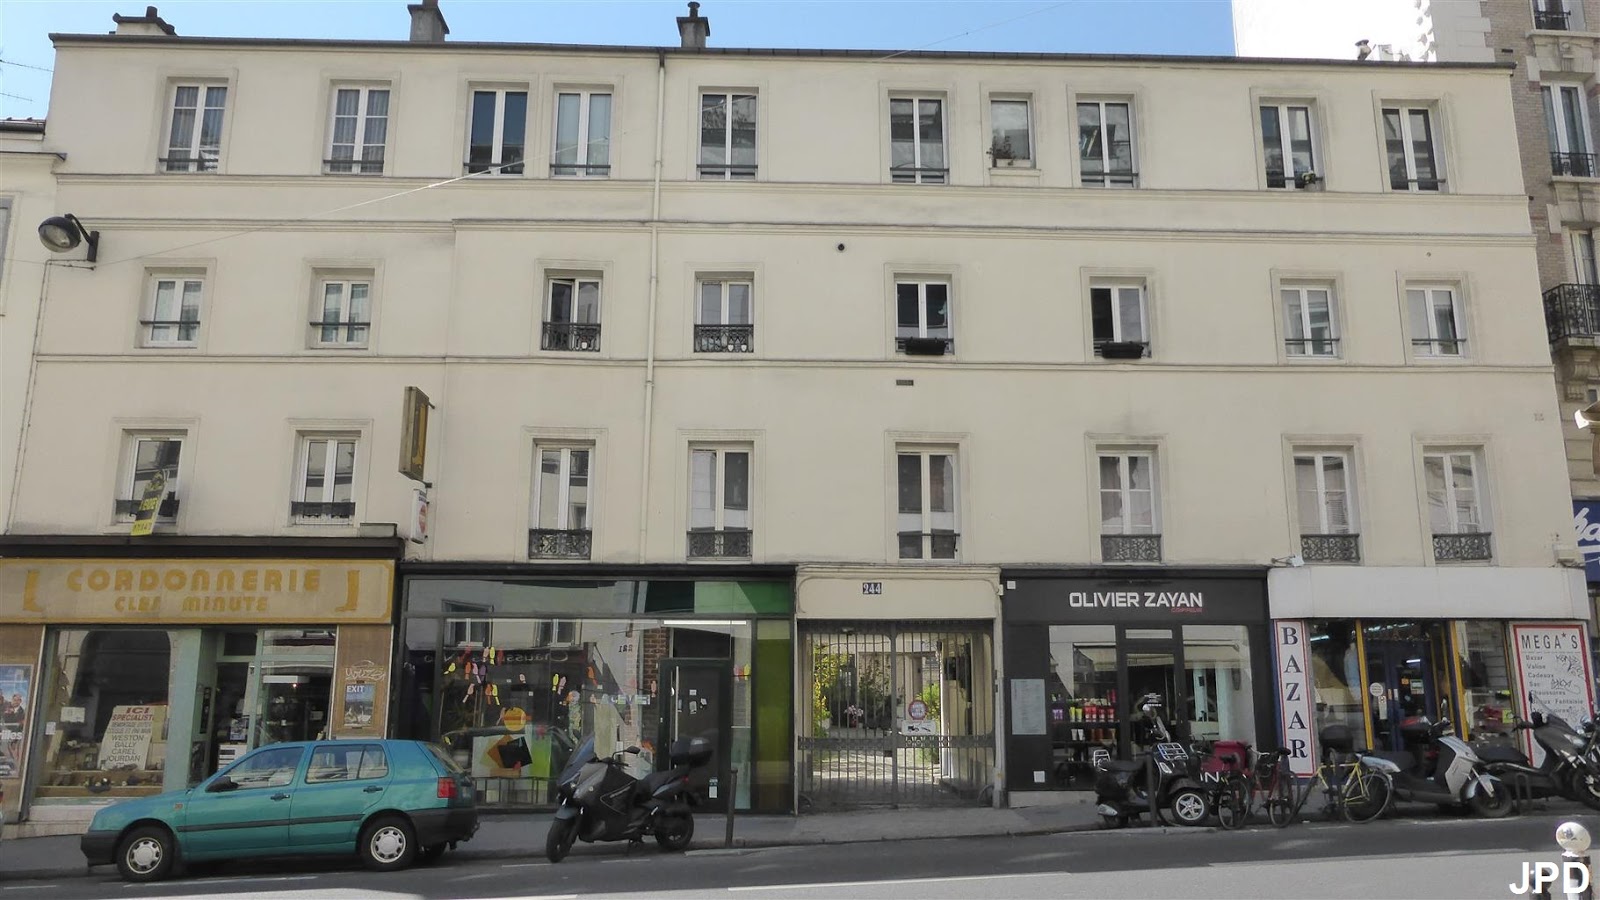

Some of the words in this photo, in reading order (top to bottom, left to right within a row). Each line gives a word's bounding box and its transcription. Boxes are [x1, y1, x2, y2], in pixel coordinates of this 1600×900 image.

[66, 569, 320, 592] CORDONNERIE
[863, 583, 881, 594] 244
[114, 596, 161, 612] CLES
[182, 596, 268, 612] MINUTE
[1069, 592, 1139, 607] OLIVIER
[1144, 592, 1202, 607] ZAYAN
[346, 685, 364, 693] EXIT
[1280, 626, 1308, 759] BAZAR
[0, 729, 22, 740] illes
